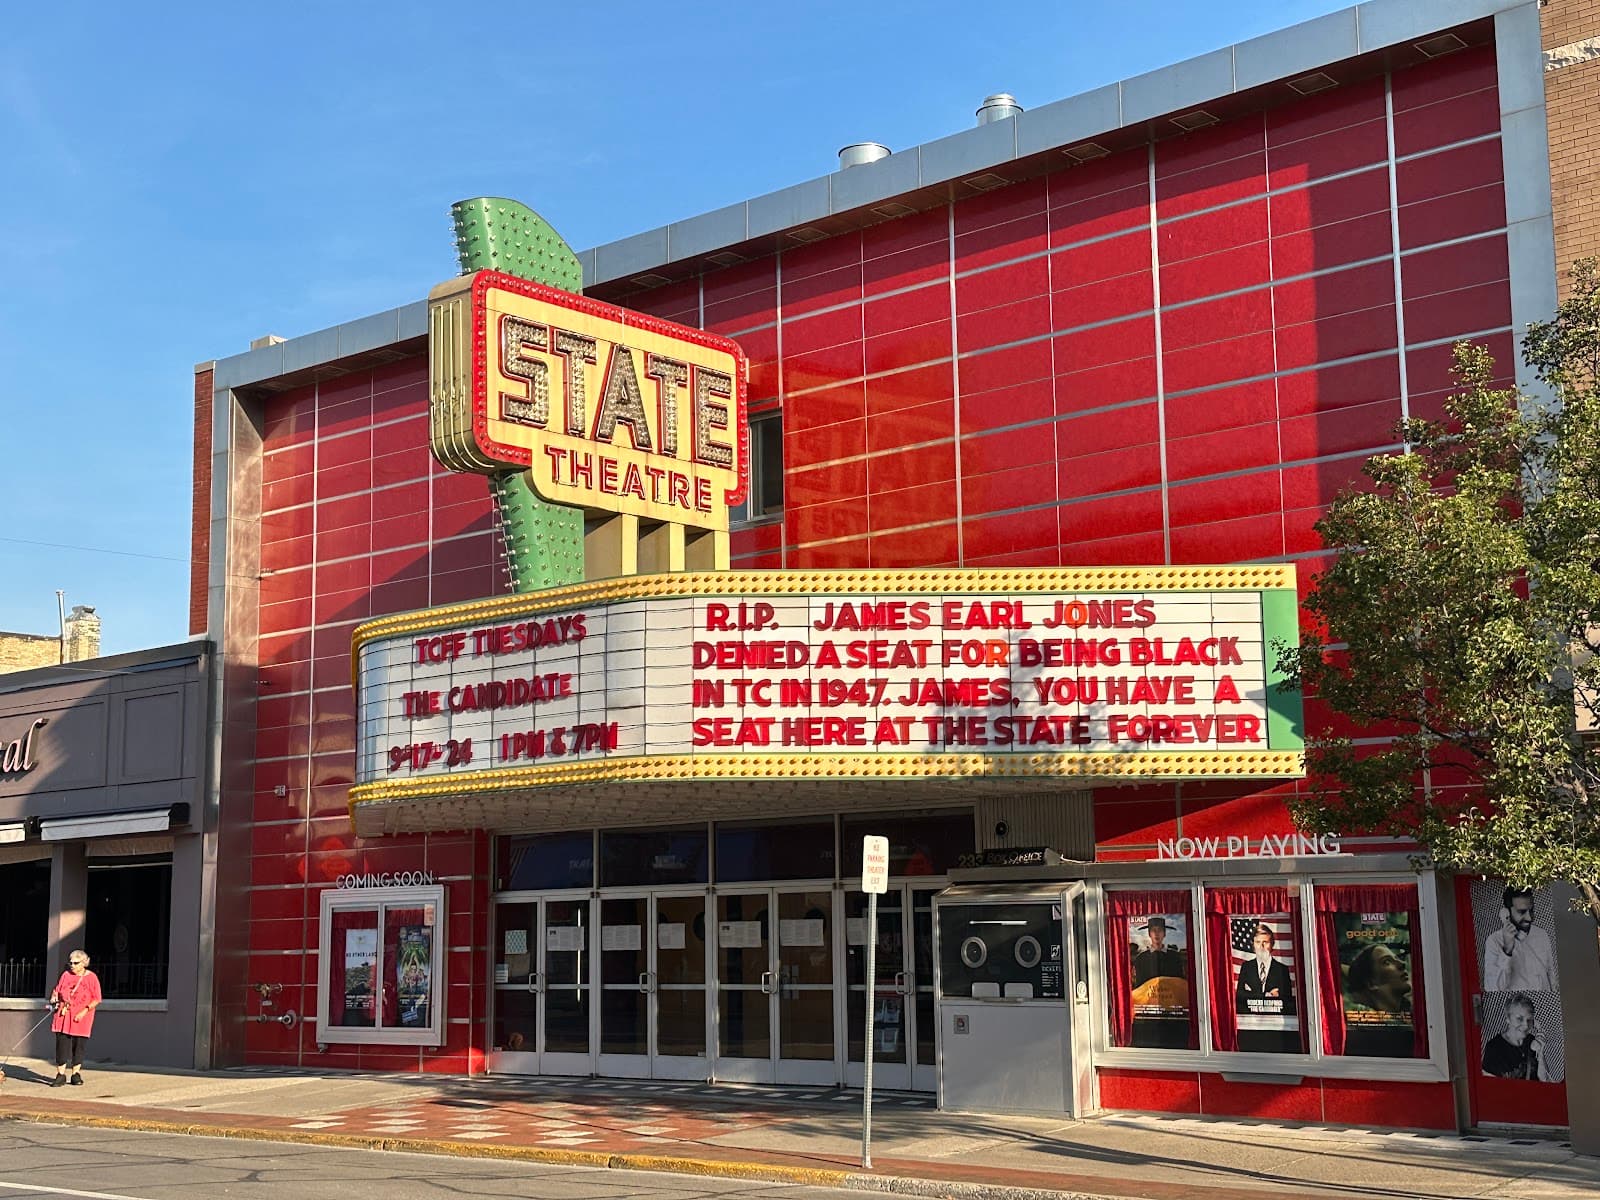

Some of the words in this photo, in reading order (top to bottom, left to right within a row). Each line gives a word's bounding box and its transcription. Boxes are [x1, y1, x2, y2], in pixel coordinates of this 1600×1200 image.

[499, 314, 733, 470] STATE
[545, 445, 713, 513] THEATRE
[706, 602, 779, 632] R.I.P.
[814, 601, 931, 632] JAMES
[941, 600, 1032, 631] EARL
[1043, 599, 1156, 630] JONES
[416, 632, 466, 664] TCFF
[472, 614, 587, 656] TUESDAYS
[692, 640, 810, 670] DENIED
[814, 640, 842, 669] A
[845, 639, 933, 669] SEAT
[941, 639, 1011, 668] FOR
[1018, 637, 1121, 668] BEING
[1128, 637, 1242, 667] BLACK
[403, 691, 441, 717] THE
[449, 672, 573, 711] CANDIDATE
[691, 679, 725, 708] IN
[731, 678, 772, 708] TC
[779, 678, 813, 708] IN
[818, 678, 892, 708] 1947.
[898, 677, 1018, 708] JAMES,
[1034, 676, 1099, 706] YOU
[1106, 675, 1196, 705] HAVE
[1213, 675, 1241, 704] A
[574, 721, 620, 751] 7PM
[691, 717, 777, 747] SEAT
[781, 716, 867, 747] HERE
[873, 716, 917, 745] AT
[922, 715, 986, 745] THE
[996, 715, 1091, 745] STATE
[1107, 714, 1261, 744] FOREVER
[1157, 836, 1219, 859] NOW
[1227, 832, 1341, 857] PLAYING
[336, 872, 390, 889] COMING
[394, 870, 433, 887] SOON
[1346, 929, 1376, 939] good
